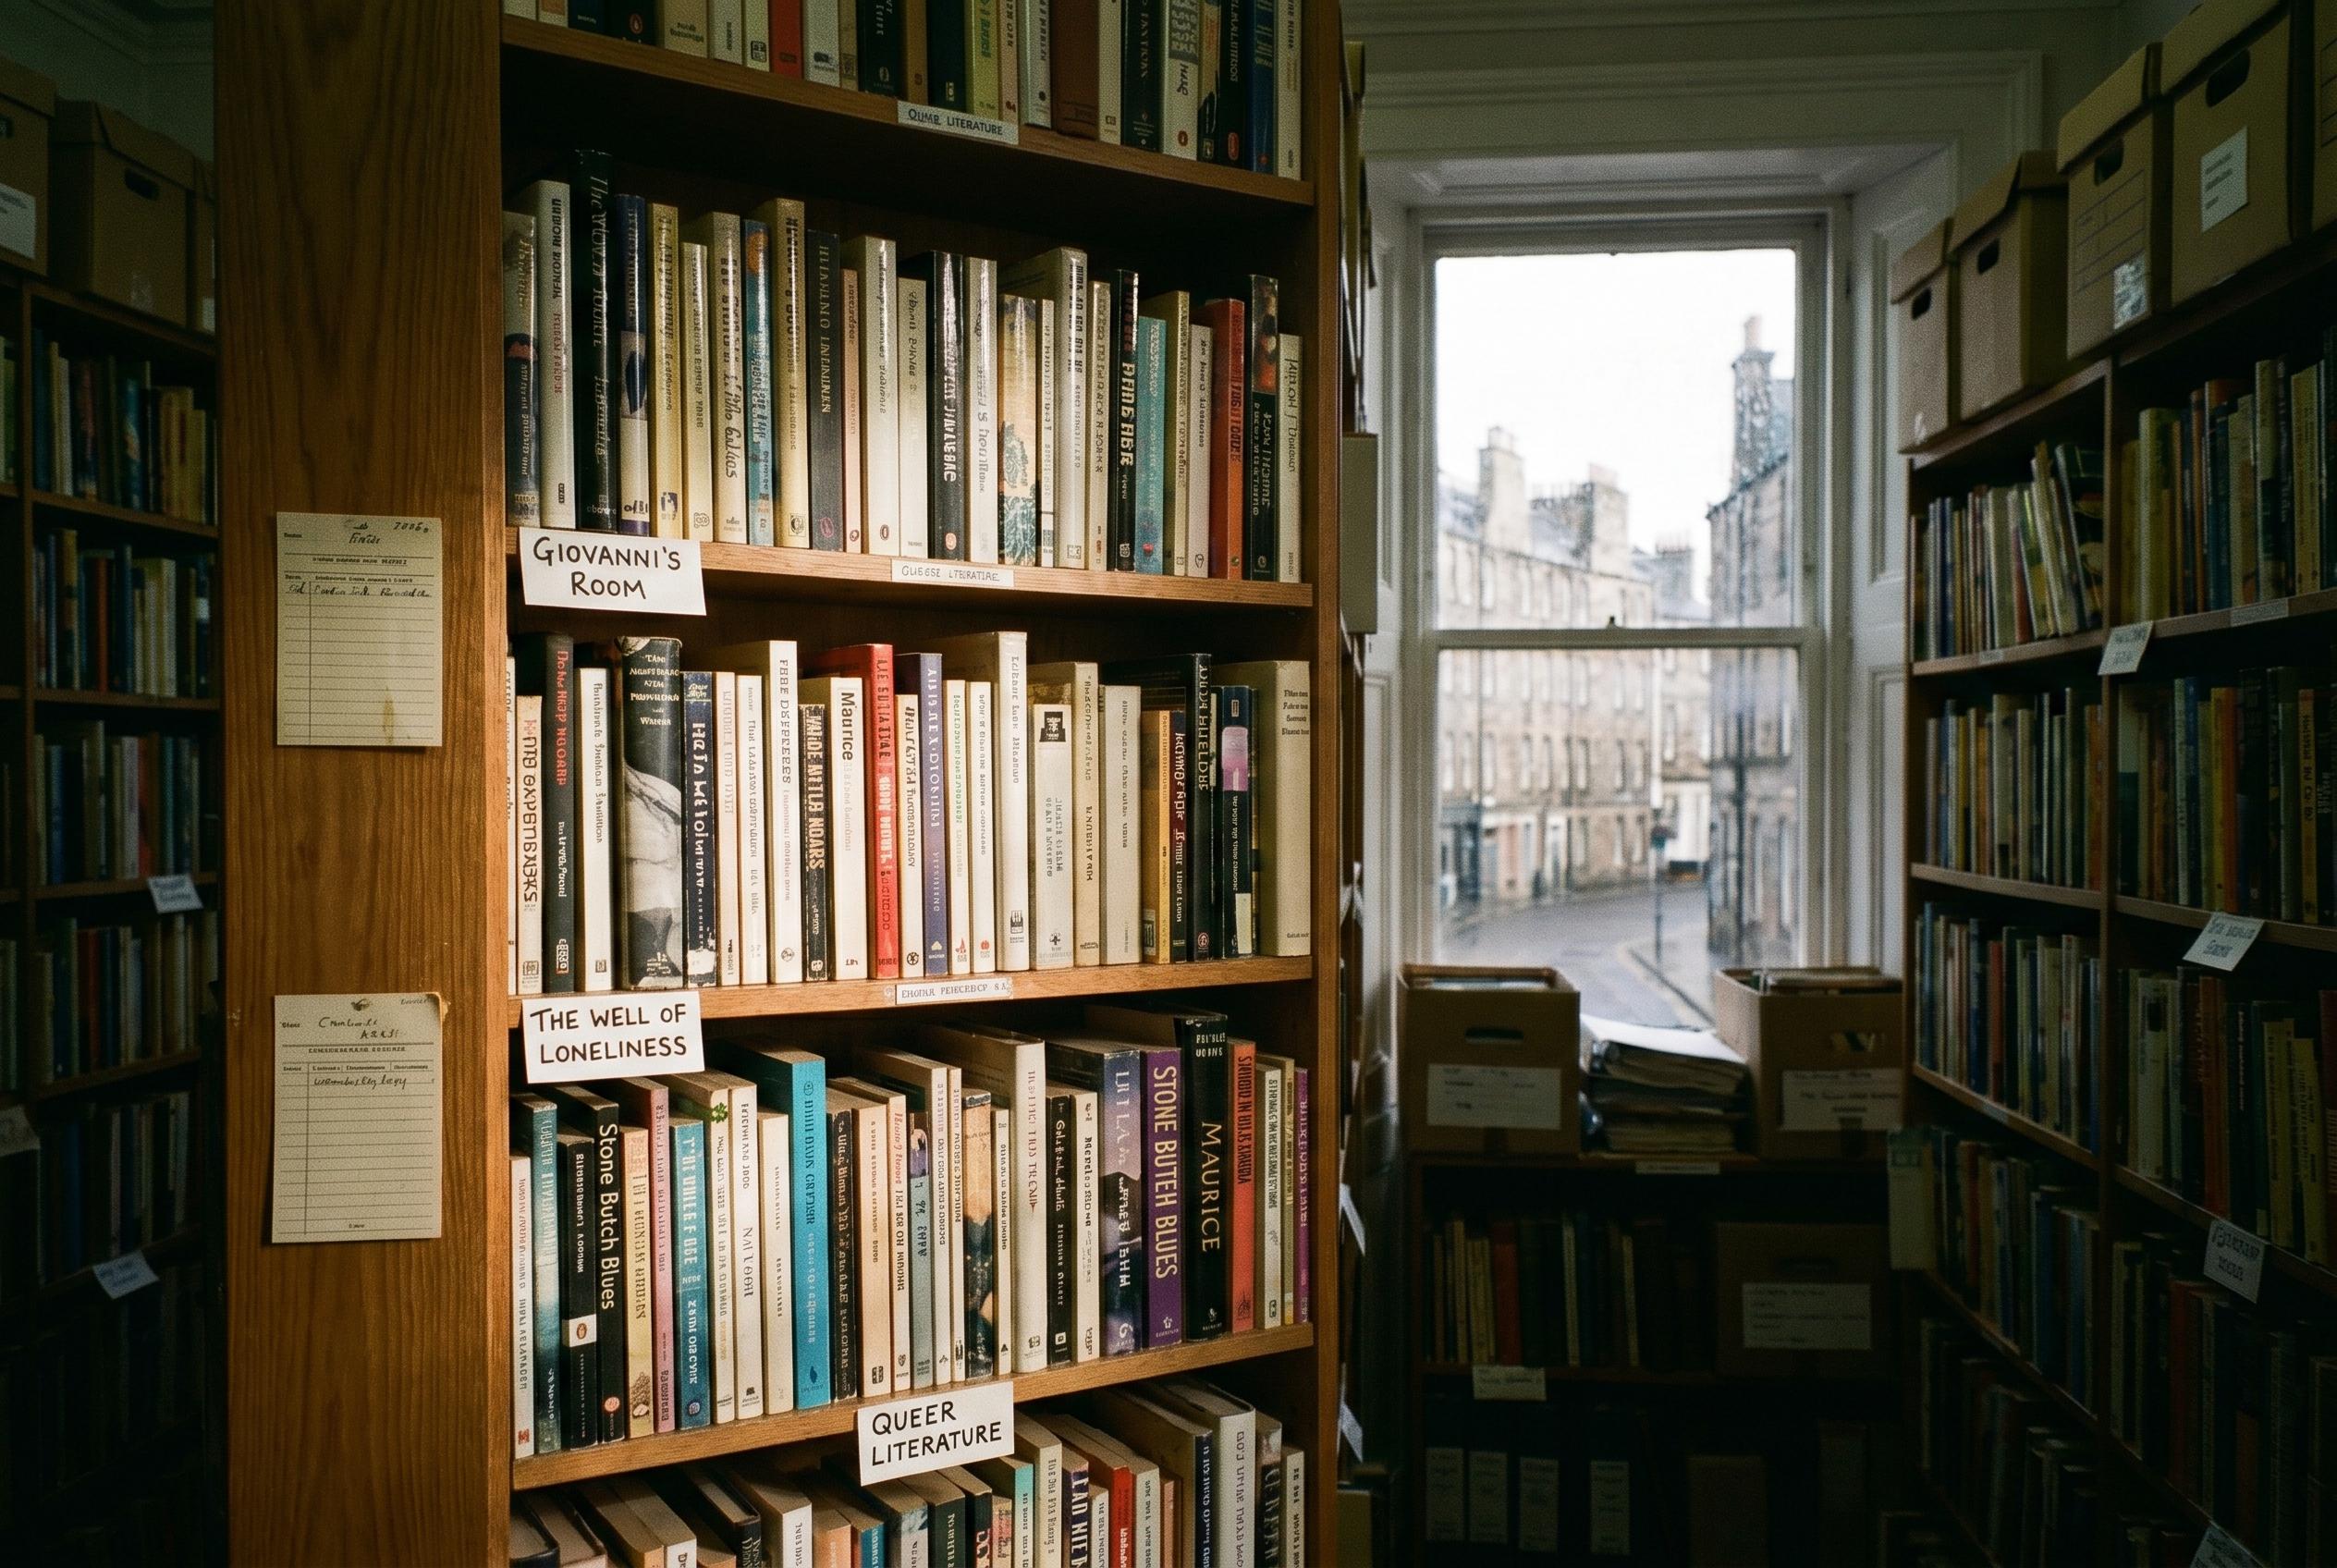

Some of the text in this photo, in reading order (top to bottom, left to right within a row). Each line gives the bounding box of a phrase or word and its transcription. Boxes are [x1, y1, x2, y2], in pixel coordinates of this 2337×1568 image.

[947, 116, 1003, 135] LITERATURE
[532, 535, 681, 571] GIOVANNI'S
[570, 570, 646, 600] ROOM
[840, 692, 858, 762] Maurice
[530, 1003, 687, 1033] THE WELL OF
[540, 1035, 687, 1064] LONELINESS
[1153, 1065, 1178, 1134] STONE
[1201, 1121, 1222, 1253] MAURICE
[597, 1123, 619, 1310] Stone Butch Blues
[1155, 1215, 1179, 1280] BLUES
[872, 1400, 957, 1436] QUEER
[872, 1421, 1003, 1466] LITERATURE
